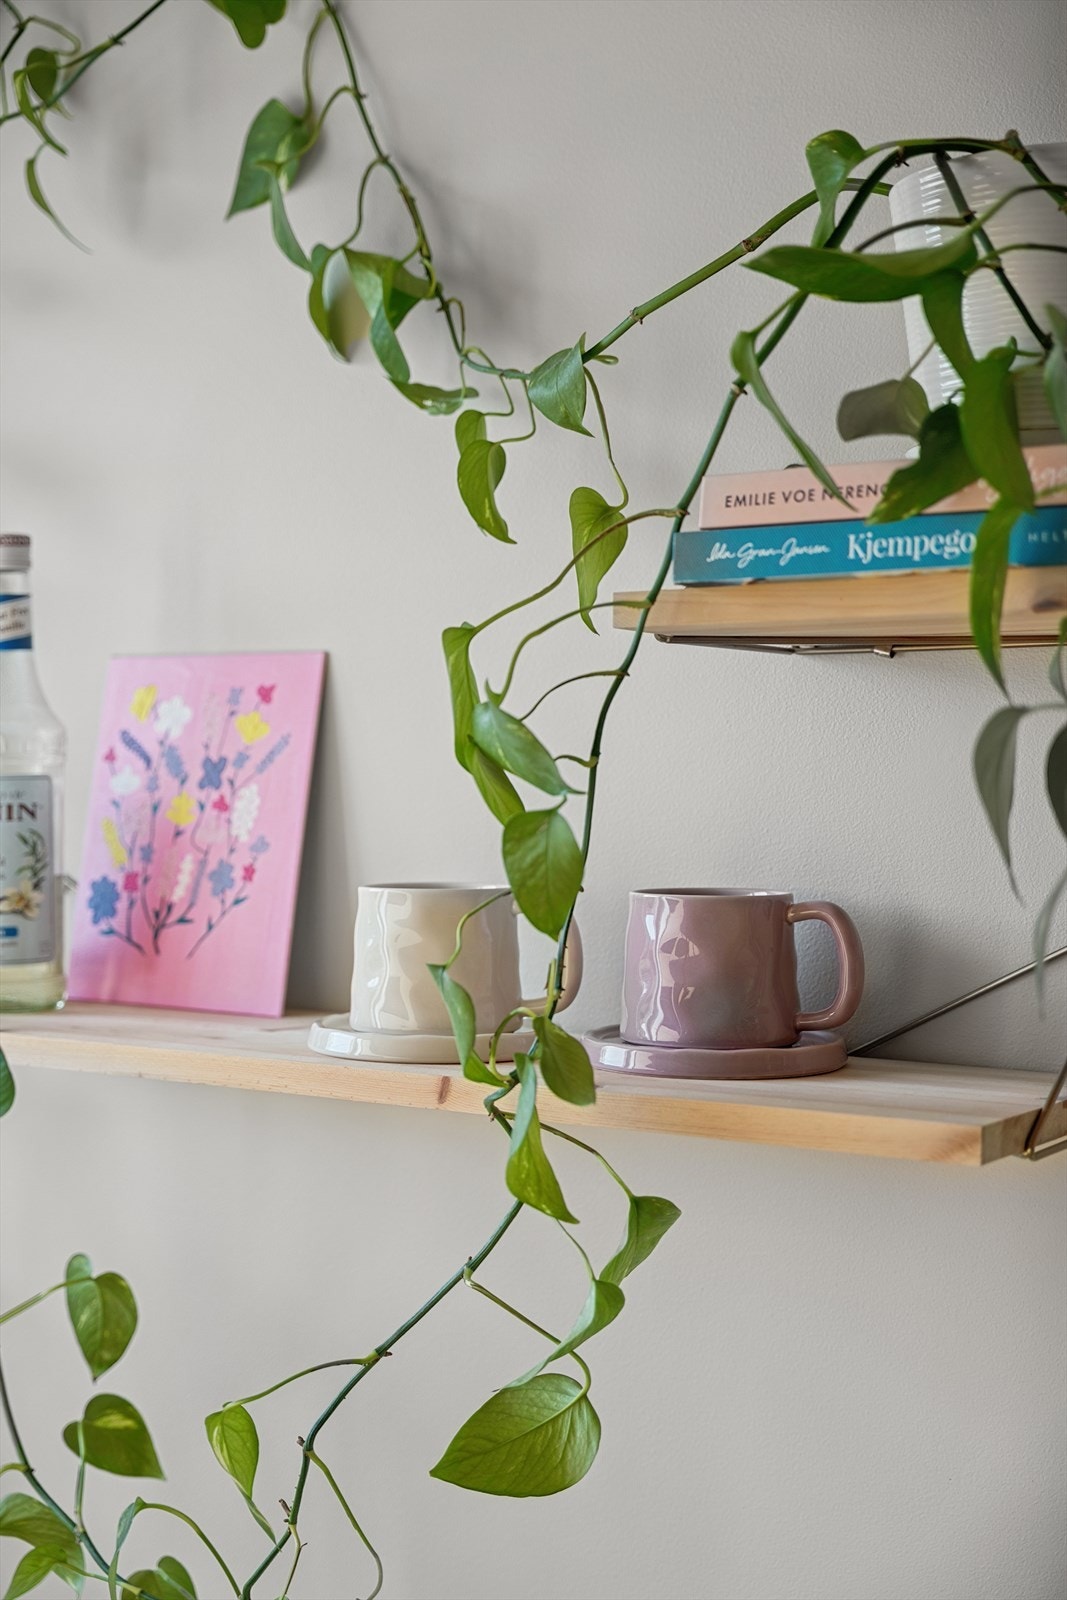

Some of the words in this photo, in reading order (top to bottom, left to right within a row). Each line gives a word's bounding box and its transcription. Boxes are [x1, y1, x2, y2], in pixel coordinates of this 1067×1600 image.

[725, 491, 776, 508] EMILIE
[782, 488, 815, 504] VOE
[0, 802, 38, 822] IN
